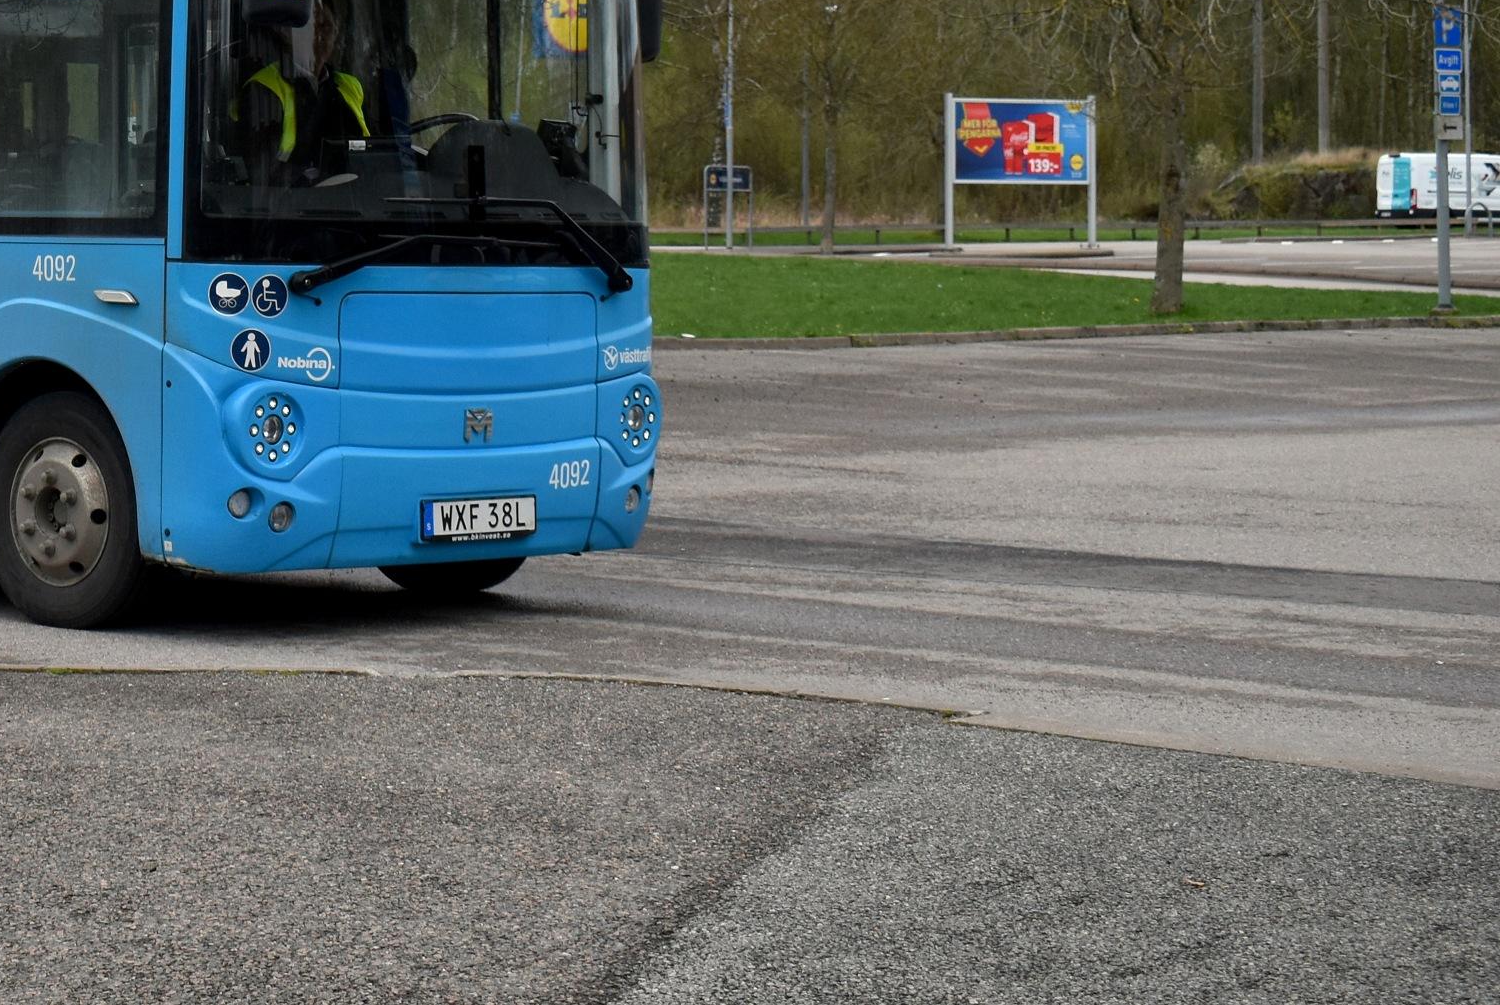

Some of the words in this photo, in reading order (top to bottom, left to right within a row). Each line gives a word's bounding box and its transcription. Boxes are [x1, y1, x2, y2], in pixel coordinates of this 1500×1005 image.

[1438, 54, 1459, 67] Avgift
[1028, 158, 1060, 173] 139:-
[32, 254, 76, 282] 4092
[549, 459, 590, 489] 4092
[440, 503, 479, 531] WXF
[488, 501, 526, 528] 38L
